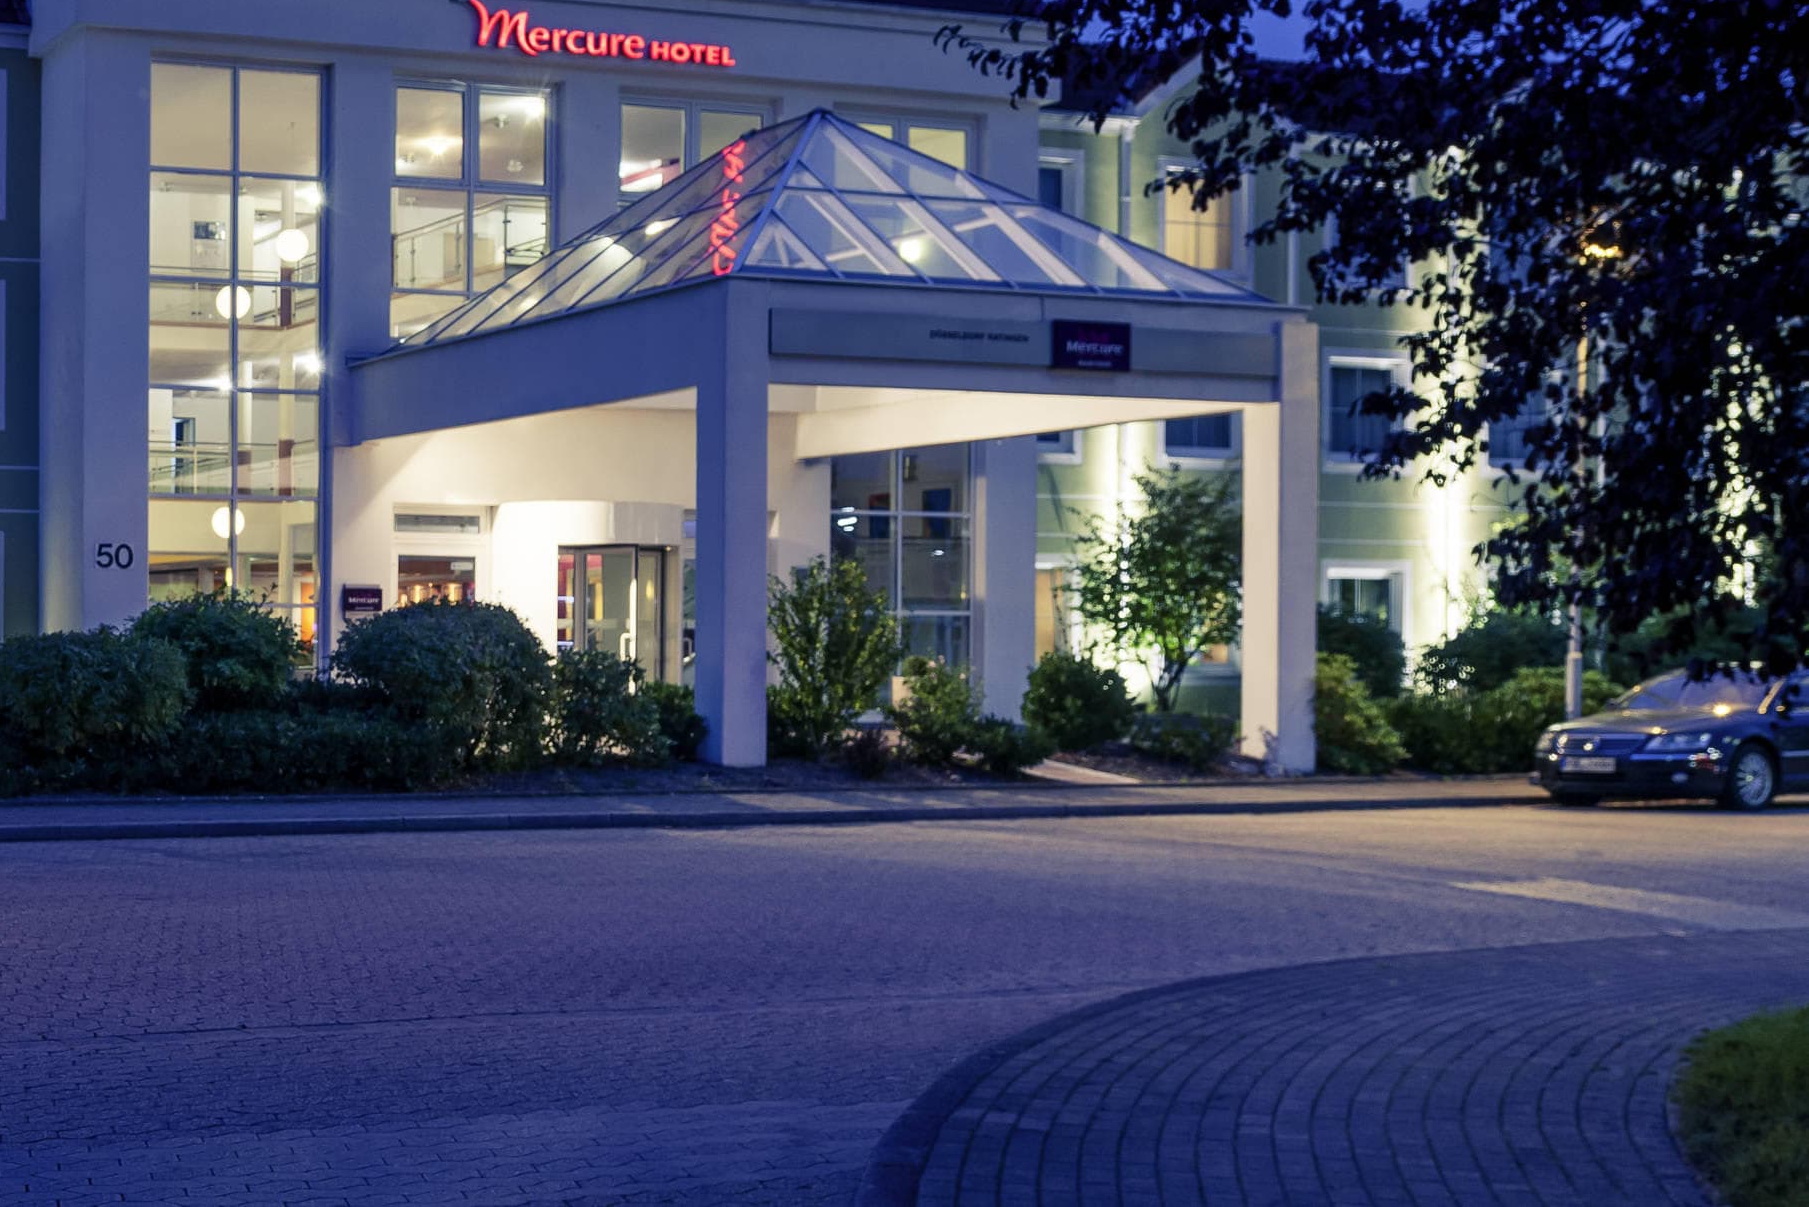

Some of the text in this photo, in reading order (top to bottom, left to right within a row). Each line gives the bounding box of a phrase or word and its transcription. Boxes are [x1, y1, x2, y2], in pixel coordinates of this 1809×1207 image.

[650, 40, 736, 66] HOTEL
[1066, 340, 1124, 355] Mercure
[95, 543, 134, 569] 50
